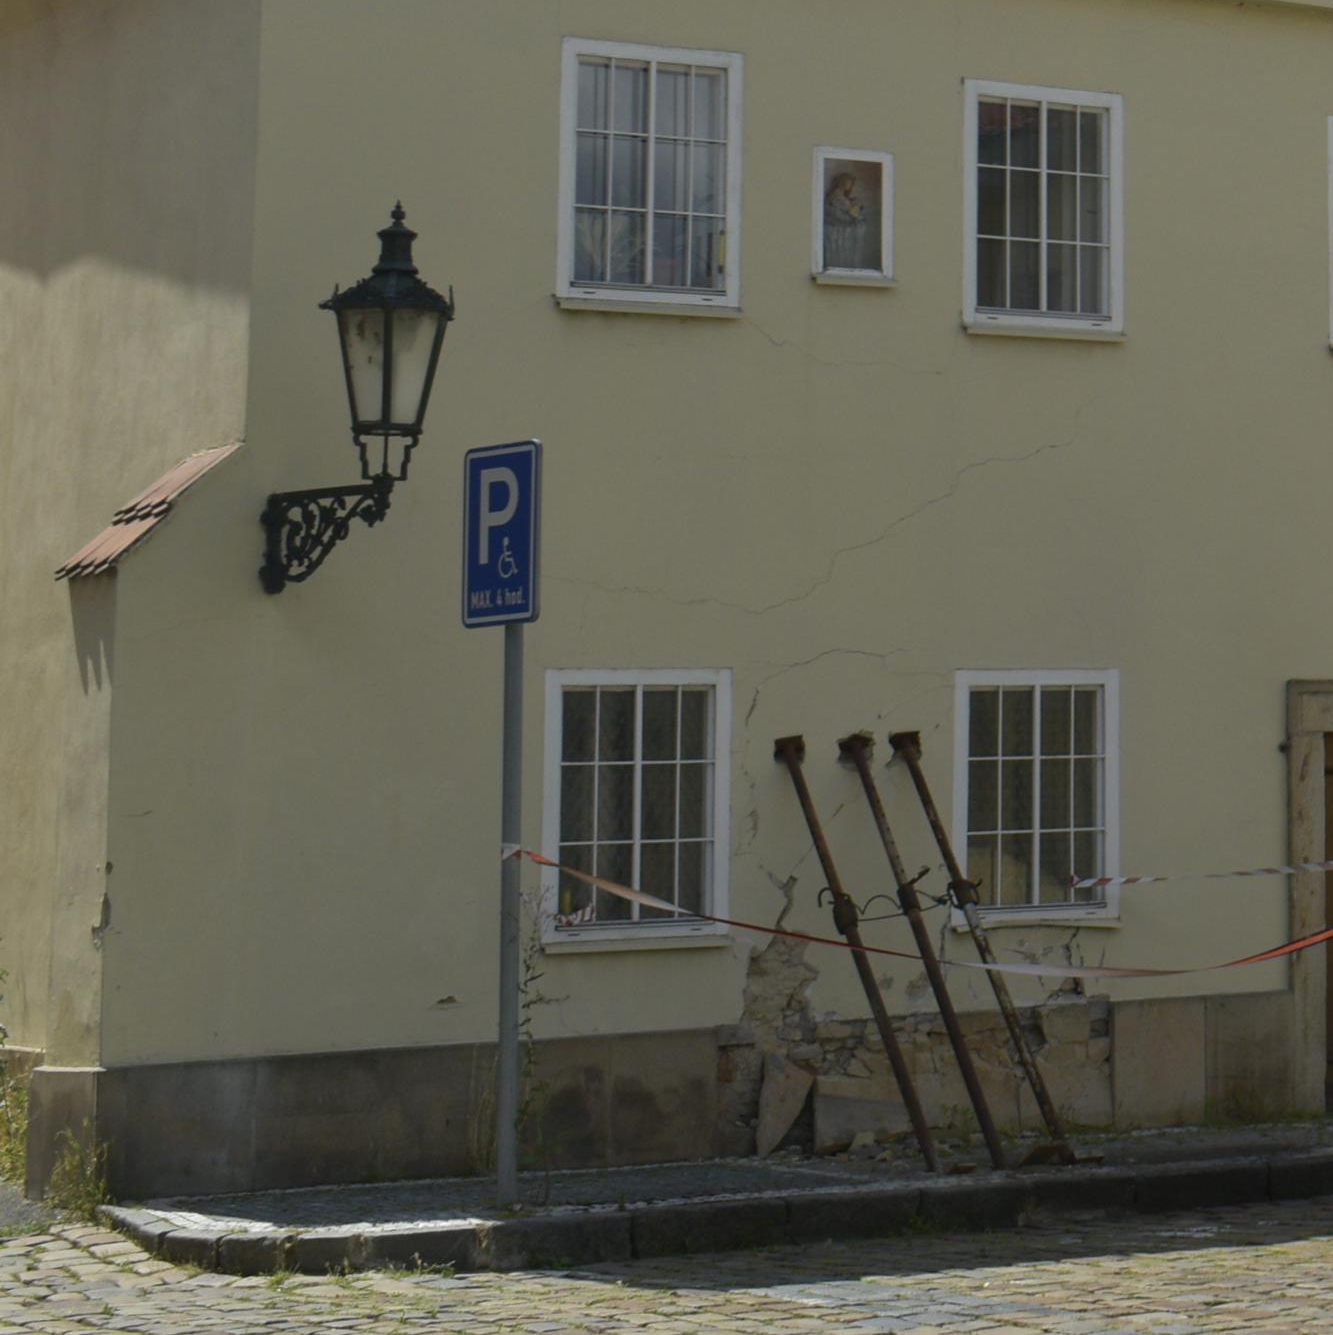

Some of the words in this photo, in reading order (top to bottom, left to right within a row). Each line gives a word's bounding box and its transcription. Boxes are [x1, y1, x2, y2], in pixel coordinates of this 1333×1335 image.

[479, 466, 519, 565] P
[471, 589, 494, 610] MAX.
[496, 588, 503, 606] 4
[505, 586, 526, 606] hod.
